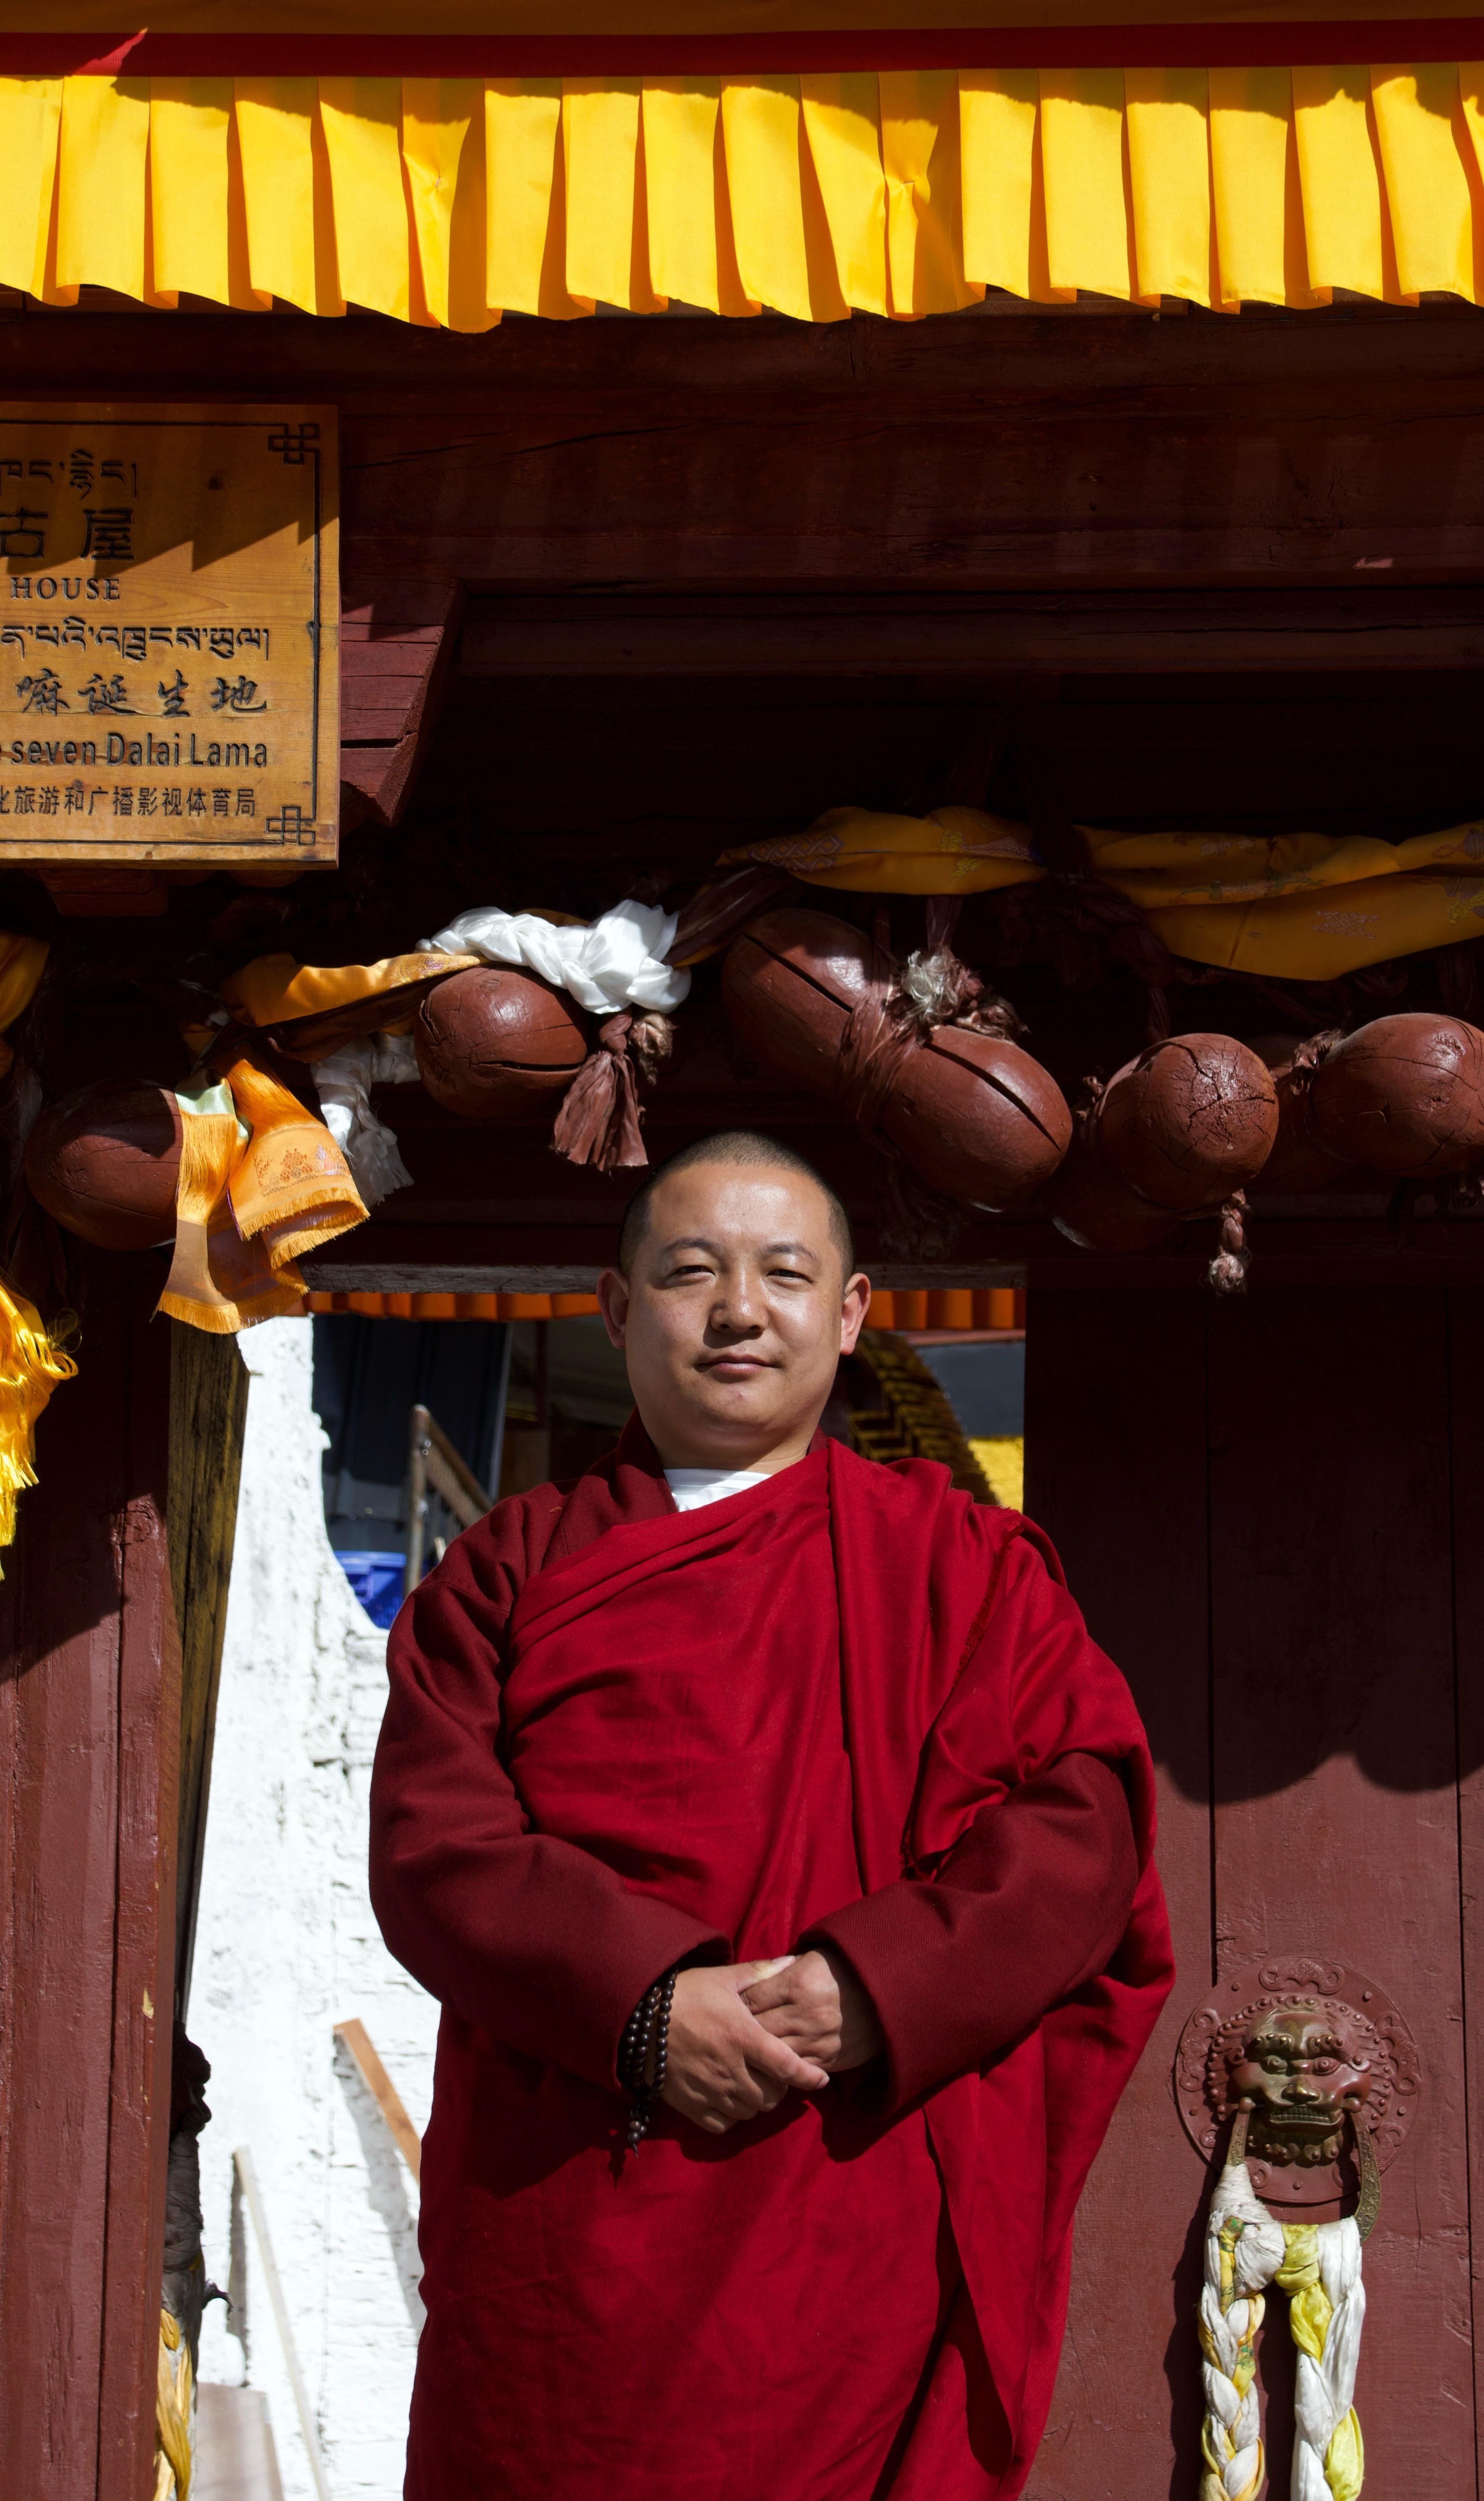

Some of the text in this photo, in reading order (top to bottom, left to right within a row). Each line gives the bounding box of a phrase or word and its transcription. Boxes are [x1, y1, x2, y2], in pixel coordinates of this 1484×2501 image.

[0, 507, 134, 560] 古屋
[10, 577, 120, 601] HOUSE
[11, 741, 95, 765] seven
[107, 732, 180, 767] Dalai
[190, 733, 267, 768] Lama
